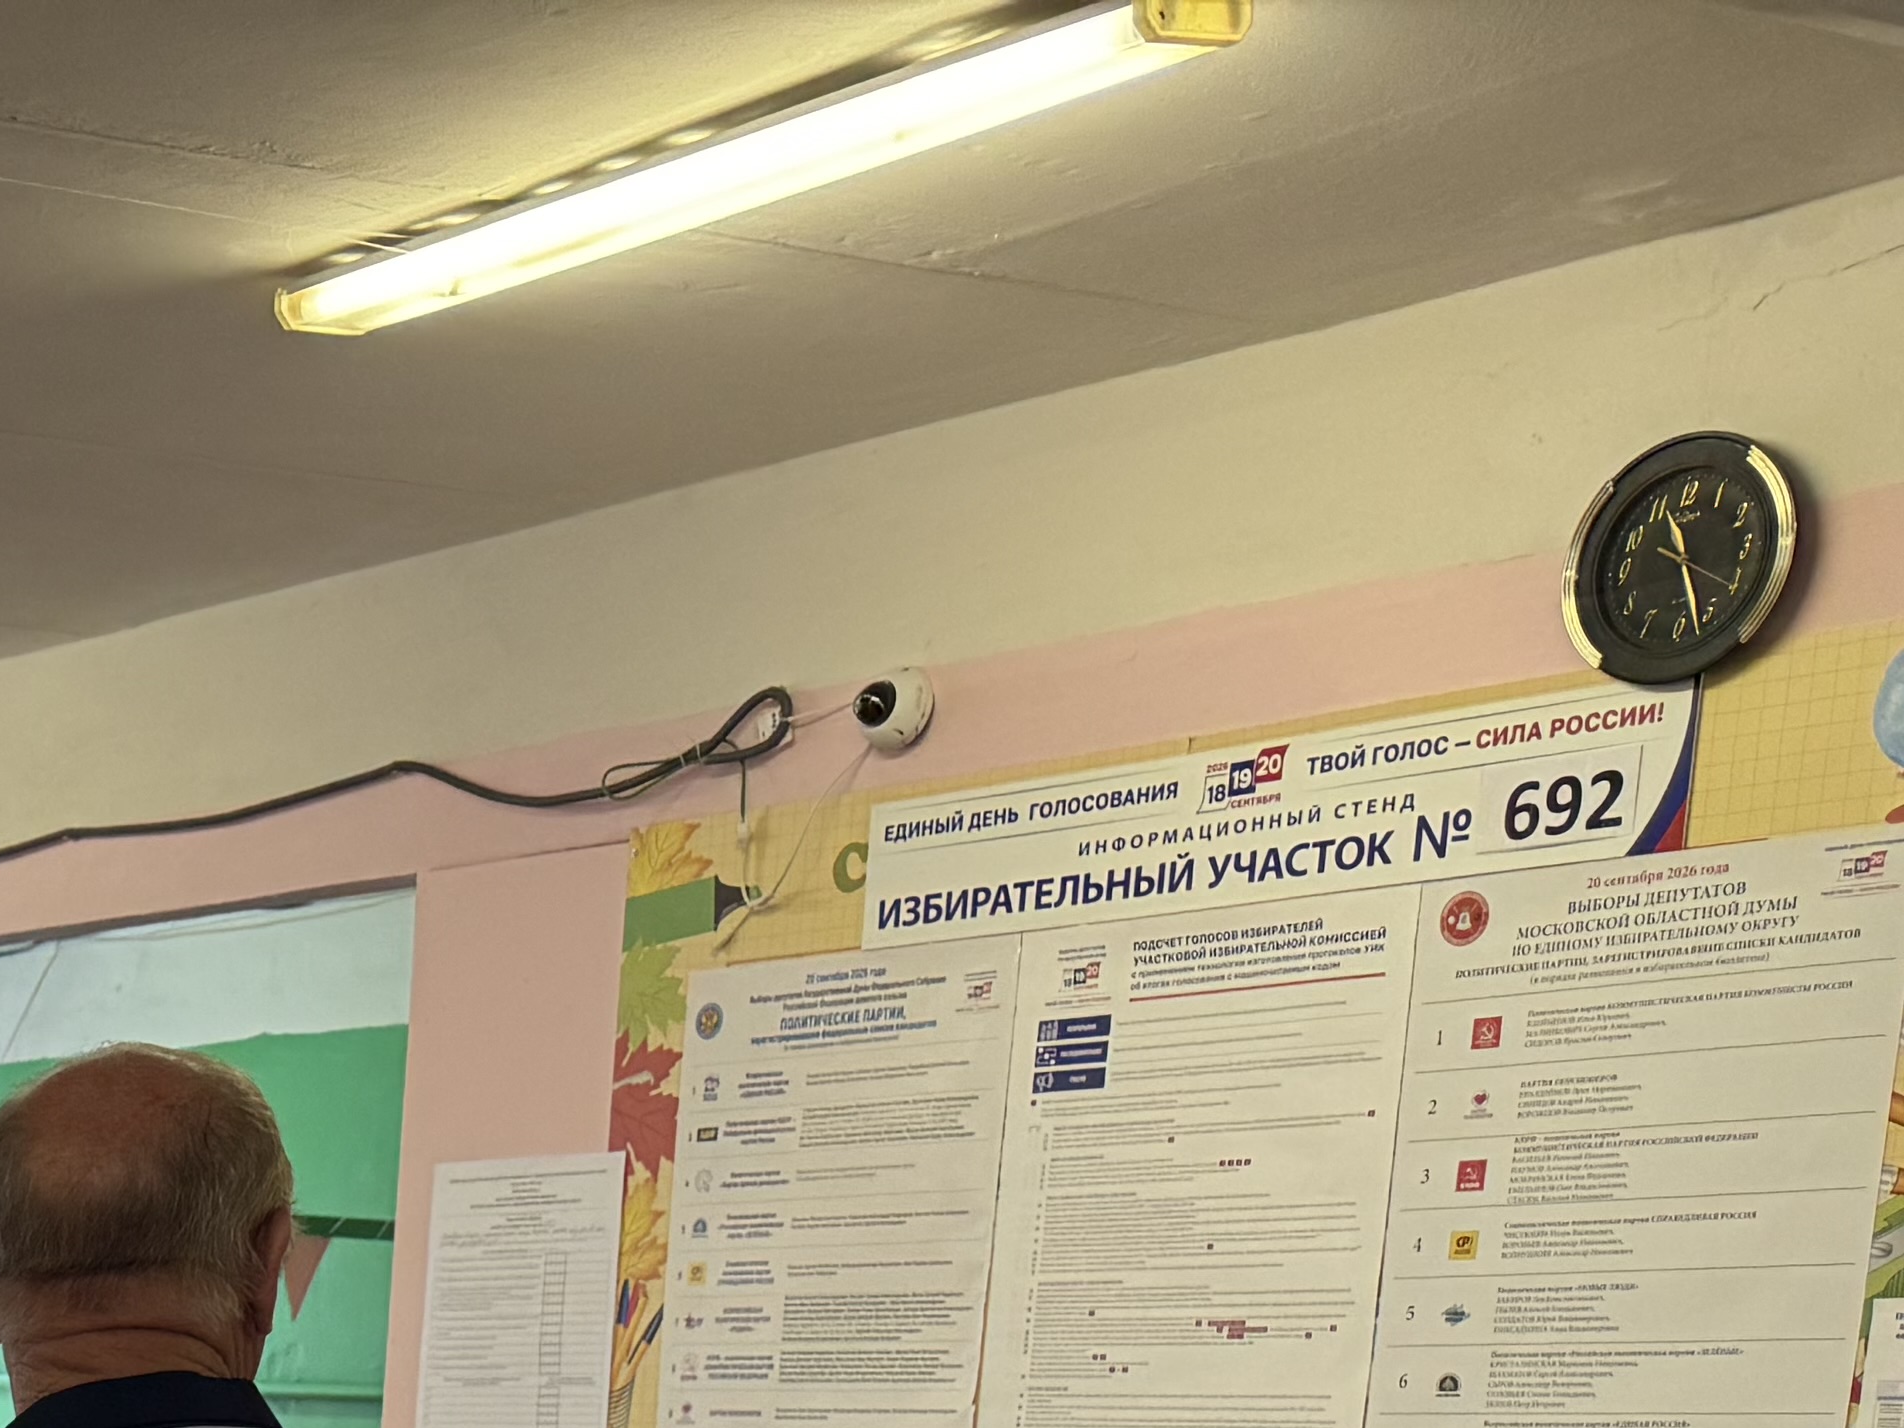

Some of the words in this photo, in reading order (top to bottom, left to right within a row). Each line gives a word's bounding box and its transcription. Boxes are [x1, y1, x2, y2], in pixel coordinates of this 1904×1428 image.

[1679, 480, 1700, 508] 12
[1714, 480, 1726, 508] 1
[1649, 495, 1668, 522] 11
[1732, 502, 1748, 528] 2
[1625, 525, 1644, 552] 10
[1739, 533, 1753, 559] 3
[1618, 558, 1632, 586] 9
[1623, 591, 1637, 616] 8
[1702, 598, 1717, 623] 5
[1640, 608, 1658, 639] 7
[1672, 614, 1686, 641] 6
[1307, 744, 1366, 776] ТВОЙ
[1372, 735, 1449, 767] ГОЛОС
[1475, 721, 1543, 750] СИЛА
[1549, 702, 1665, 738] РОССИИ!
[1207, 784, 1226, 804] 18
[1232, 768, 1252, 790] 19
[1256, 753, 1282, 777] 20
[884, 809, 965, 843] ЕДИНЫЙ
[968, 807, 1020, 834] ДЕНЬ
[1029, 781, 1179, 822] ГОЛОСОВАНИЯ
[1231, 793, 1281, 809] СЕНТЯБРЯ
[1079, 806, 1322, 857] ИНФОРМАЦИОННЫЙ
[1334, 792, 1417, 820] СТЕНД
[878, 853, 1194, 930] ИЗБИРАТЕЛЬНЫЙ
[1207, 829, 1395, 888] УЧАСТОК
[1412, 807, 1472, 862] №
[1504, 769, 1624, 842] 692
[1587, 877, 1600, 889] 20
[1604, 870, 1663, 888] сентября
[1667, 866, 1697, 879] 2026
[1700, 863, 1730, 877] года
[1568, 893, 1640, 915] ВЫБОРЫ
[1643, 881, 1747, 908] ДЕПУТАТОВ
[1516, 913, 1629, 940] МОСКОВСКОЙ
[1634, 900, 1740, 926] ОБЛАСТНОЙ
[1742, 896, 1798, 917] ДУМЫ
[1133, 936, 1184, 952] ПОДСЧЕТ
[1185, 929, 1239, 946] ГОЛОСОВ
[1241, 917, 1324, 939] ИЗБИРАТЕЛЕЙ
[1133, 945, 1207, 967] УЧАСТКОВОЙ
[1209, 935, 1307, 958] ИЗБИРАТЕЛЬНОЙ
[1308, 925, 1387, 946] КОМИССИЕЙ
[1512, 943, 1532, 957] ПО
[1534, 937, 1603, 956] ЕДИНОМУ
[1606, 922, 1739, 947] ИЗБИРАТЕЛЬНОМУ
[1742, 915, 1800, 933] ОКРУГУ
[1778, 928, 1861, 946] КАНДИДАТОВ
[780, 1011, 860, 1031] ПОЛИТИЧЕСКИЕ
[862, 1005, 907, 1023] ПАРТИИ,
[1435, 1029, 1443, 1047] 1
[1427, 1099, 1438, 1115] 2
[1420, 1168, 1430, 1184] 3
[1413, 1236, 1422, 1252] 4
[1404, 1305, 1416, 1320] 5
[1398, 1373, 1408, 1388] 6
